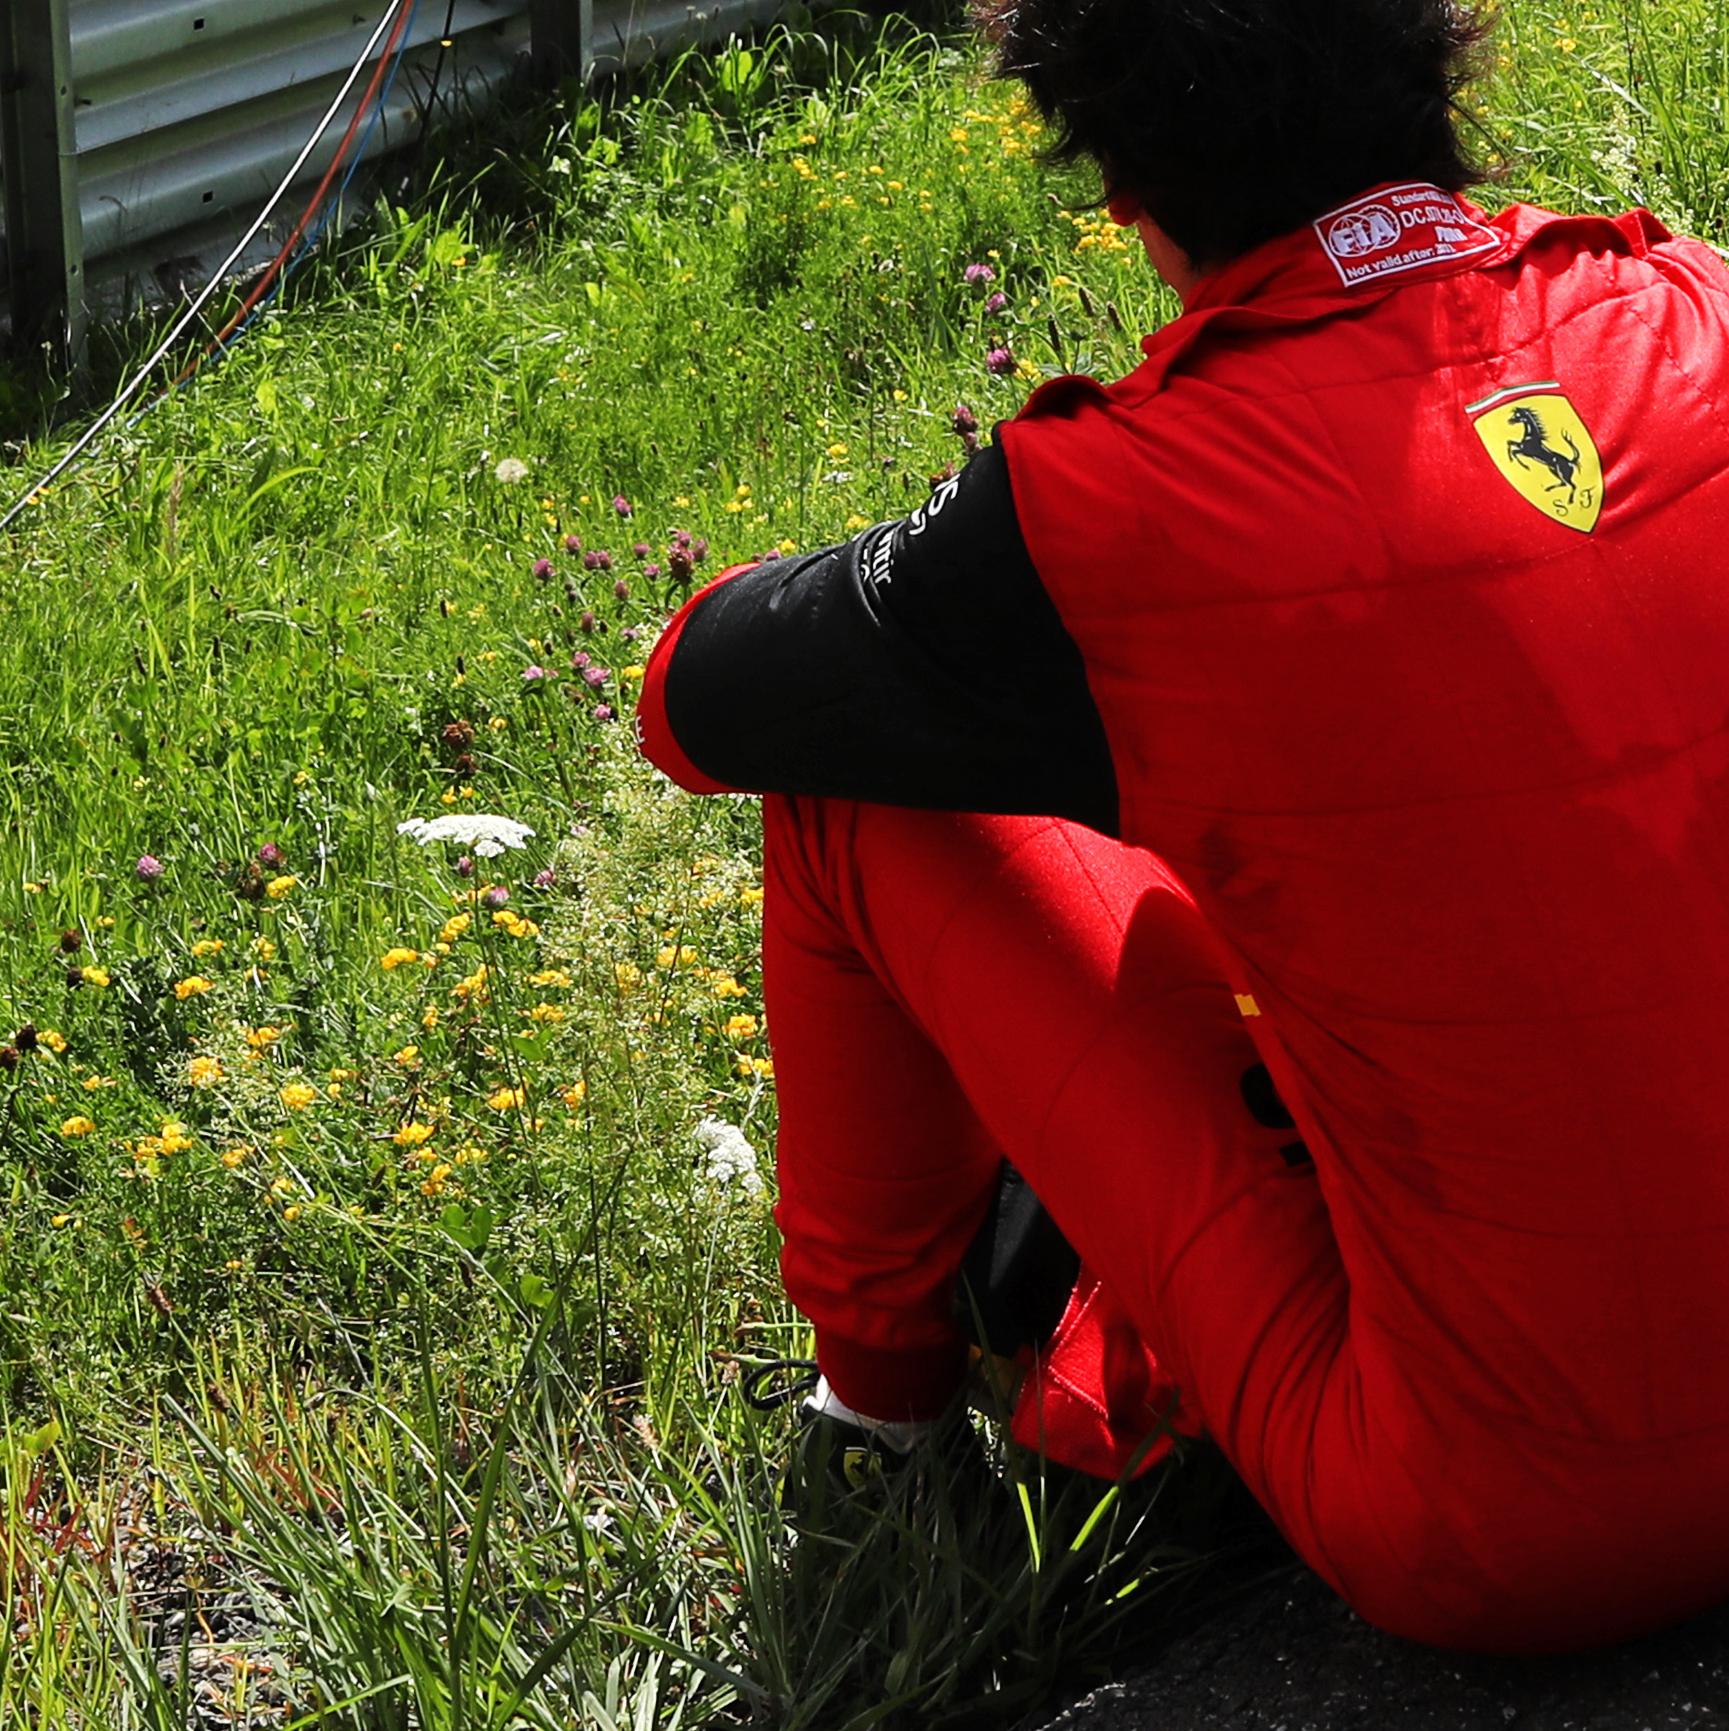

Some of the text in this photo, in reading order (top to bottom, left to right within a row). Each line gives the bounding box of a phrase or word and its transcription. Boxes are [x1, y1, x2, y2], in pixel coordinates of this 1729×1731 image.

[1332, 213, 1397, 255] FIA
[1346, 265, 1373, 279] Not
[1374, 256, 1403, 271] valid
[1553, 485, 1597, 517] S F
